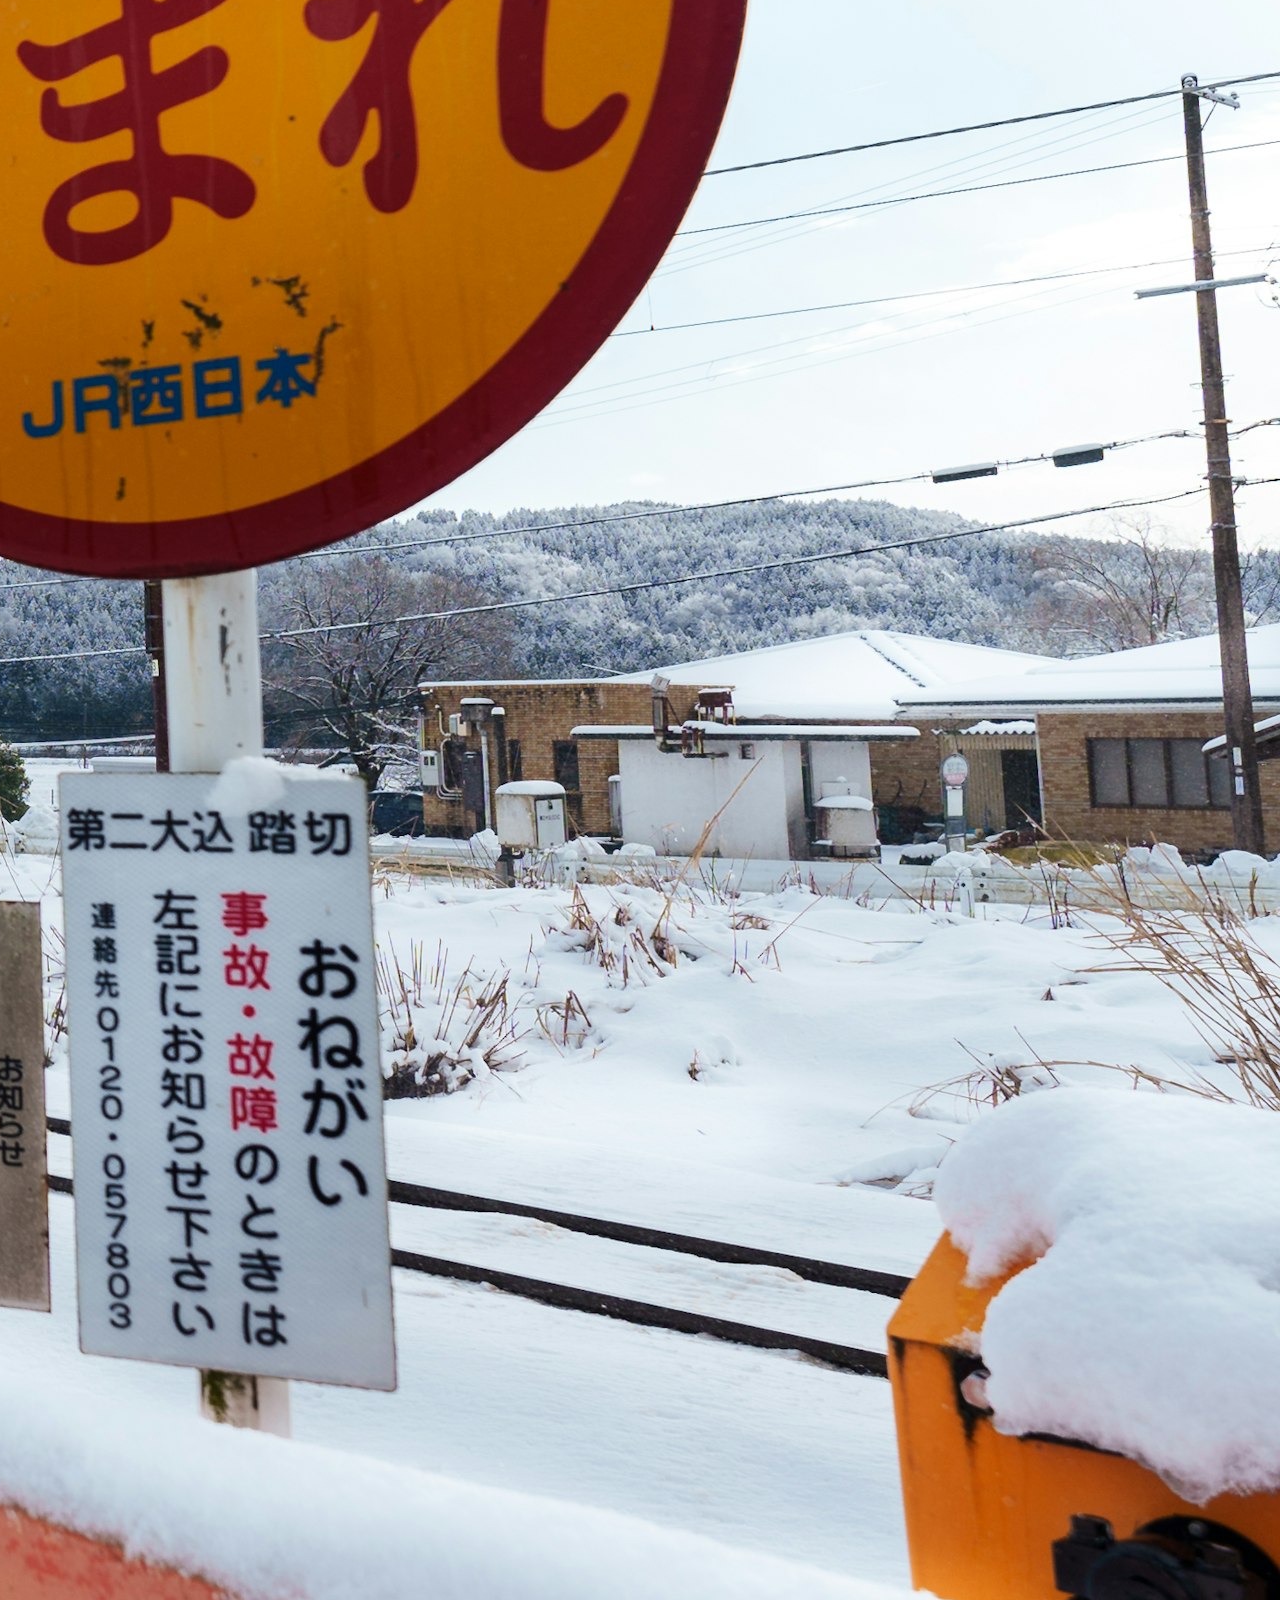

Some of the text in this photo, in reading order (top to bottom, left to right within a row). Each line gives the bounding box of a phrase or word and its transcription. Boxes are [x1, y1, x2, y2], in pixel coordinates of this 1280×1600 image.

[22, 348, 318, 440] JR西日本
[153, 890, 215, 1337] 左記にお知らせ下さい
[221, 891, 288, 1348] 事故・故障のときは
[299, 939, 369, 1207] おねがい
